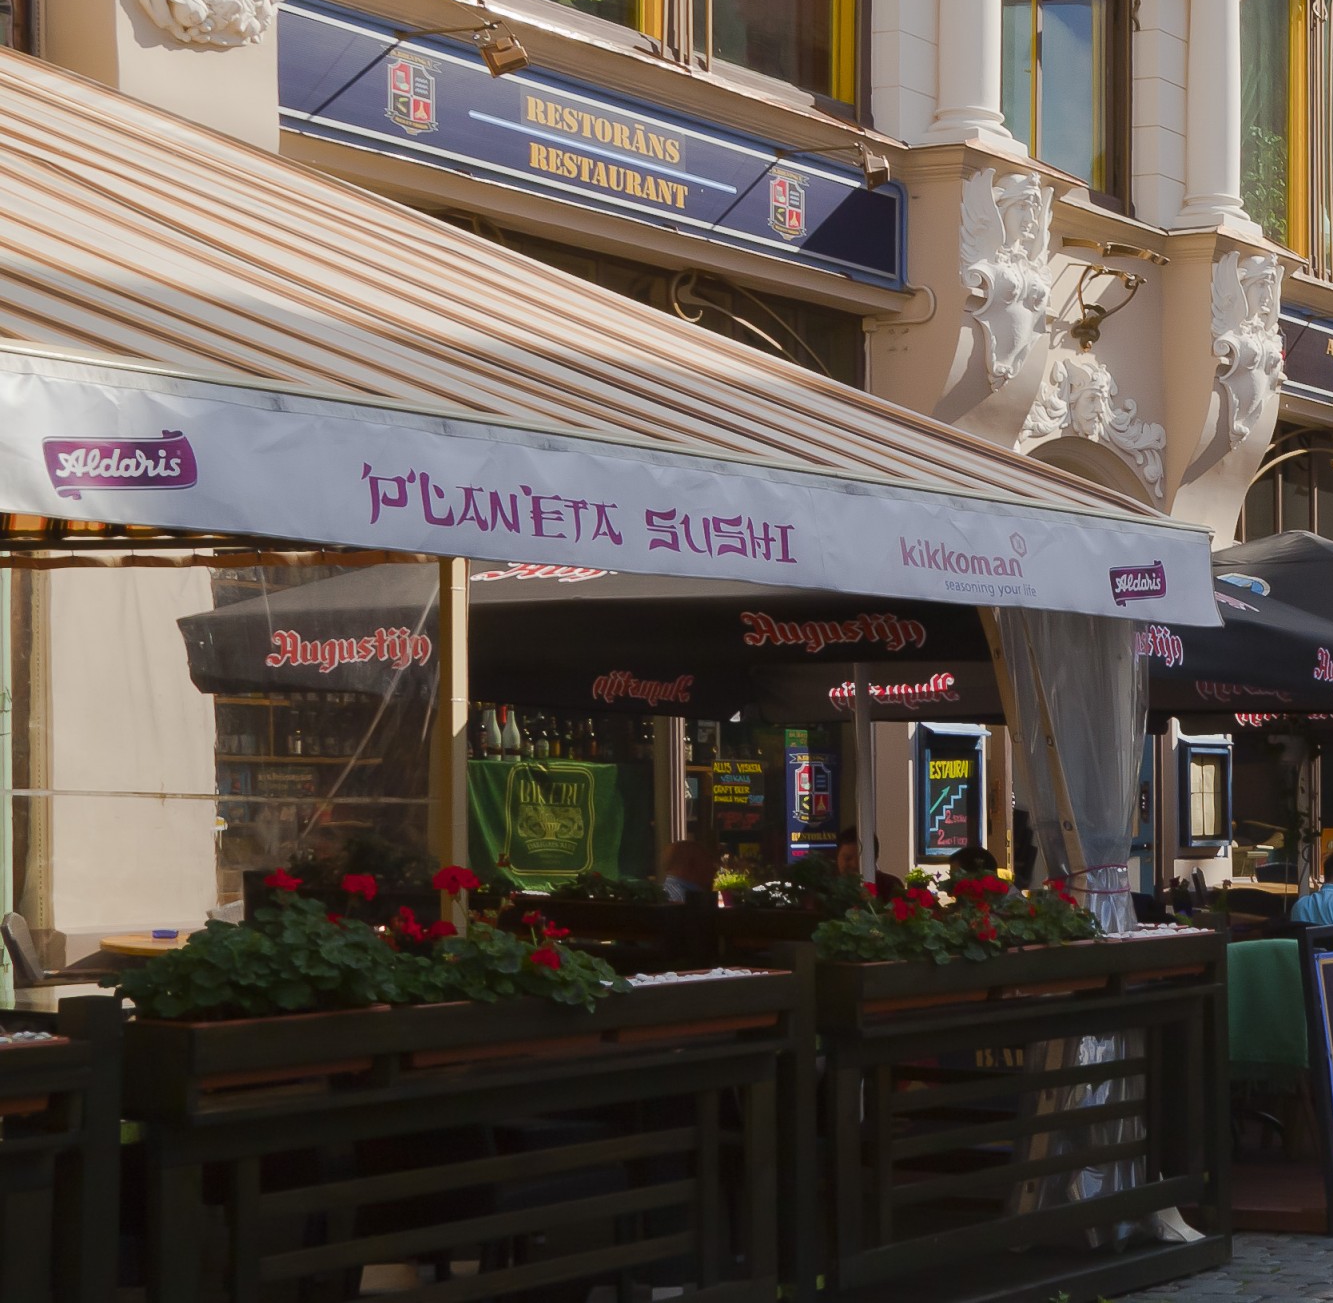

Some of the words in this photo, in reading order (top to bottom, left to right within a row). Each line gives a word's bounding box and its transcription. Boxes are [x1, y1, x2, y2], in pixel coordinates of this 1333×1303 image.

[526, 95, 681, 164] RESTORĀNS
[529, 142, 689, 209] RESTAURANT
[56, 449, 181, 477] Aldaris
[362, 462, 623, 545] PLANETA
[645, 507, 798, 564] SUSHI
[900, 536, 1023, 578] kikkoman
[945, 579, 995, 597] seasoning
[997, 584, 1021, 597] your
[1023, 583, 1037, 597] life
[1115, 573, 1162, 593] Aldaris
[266, 627, 432, 673] Augustijn
[740, 611, 926, 653] Augustijn
